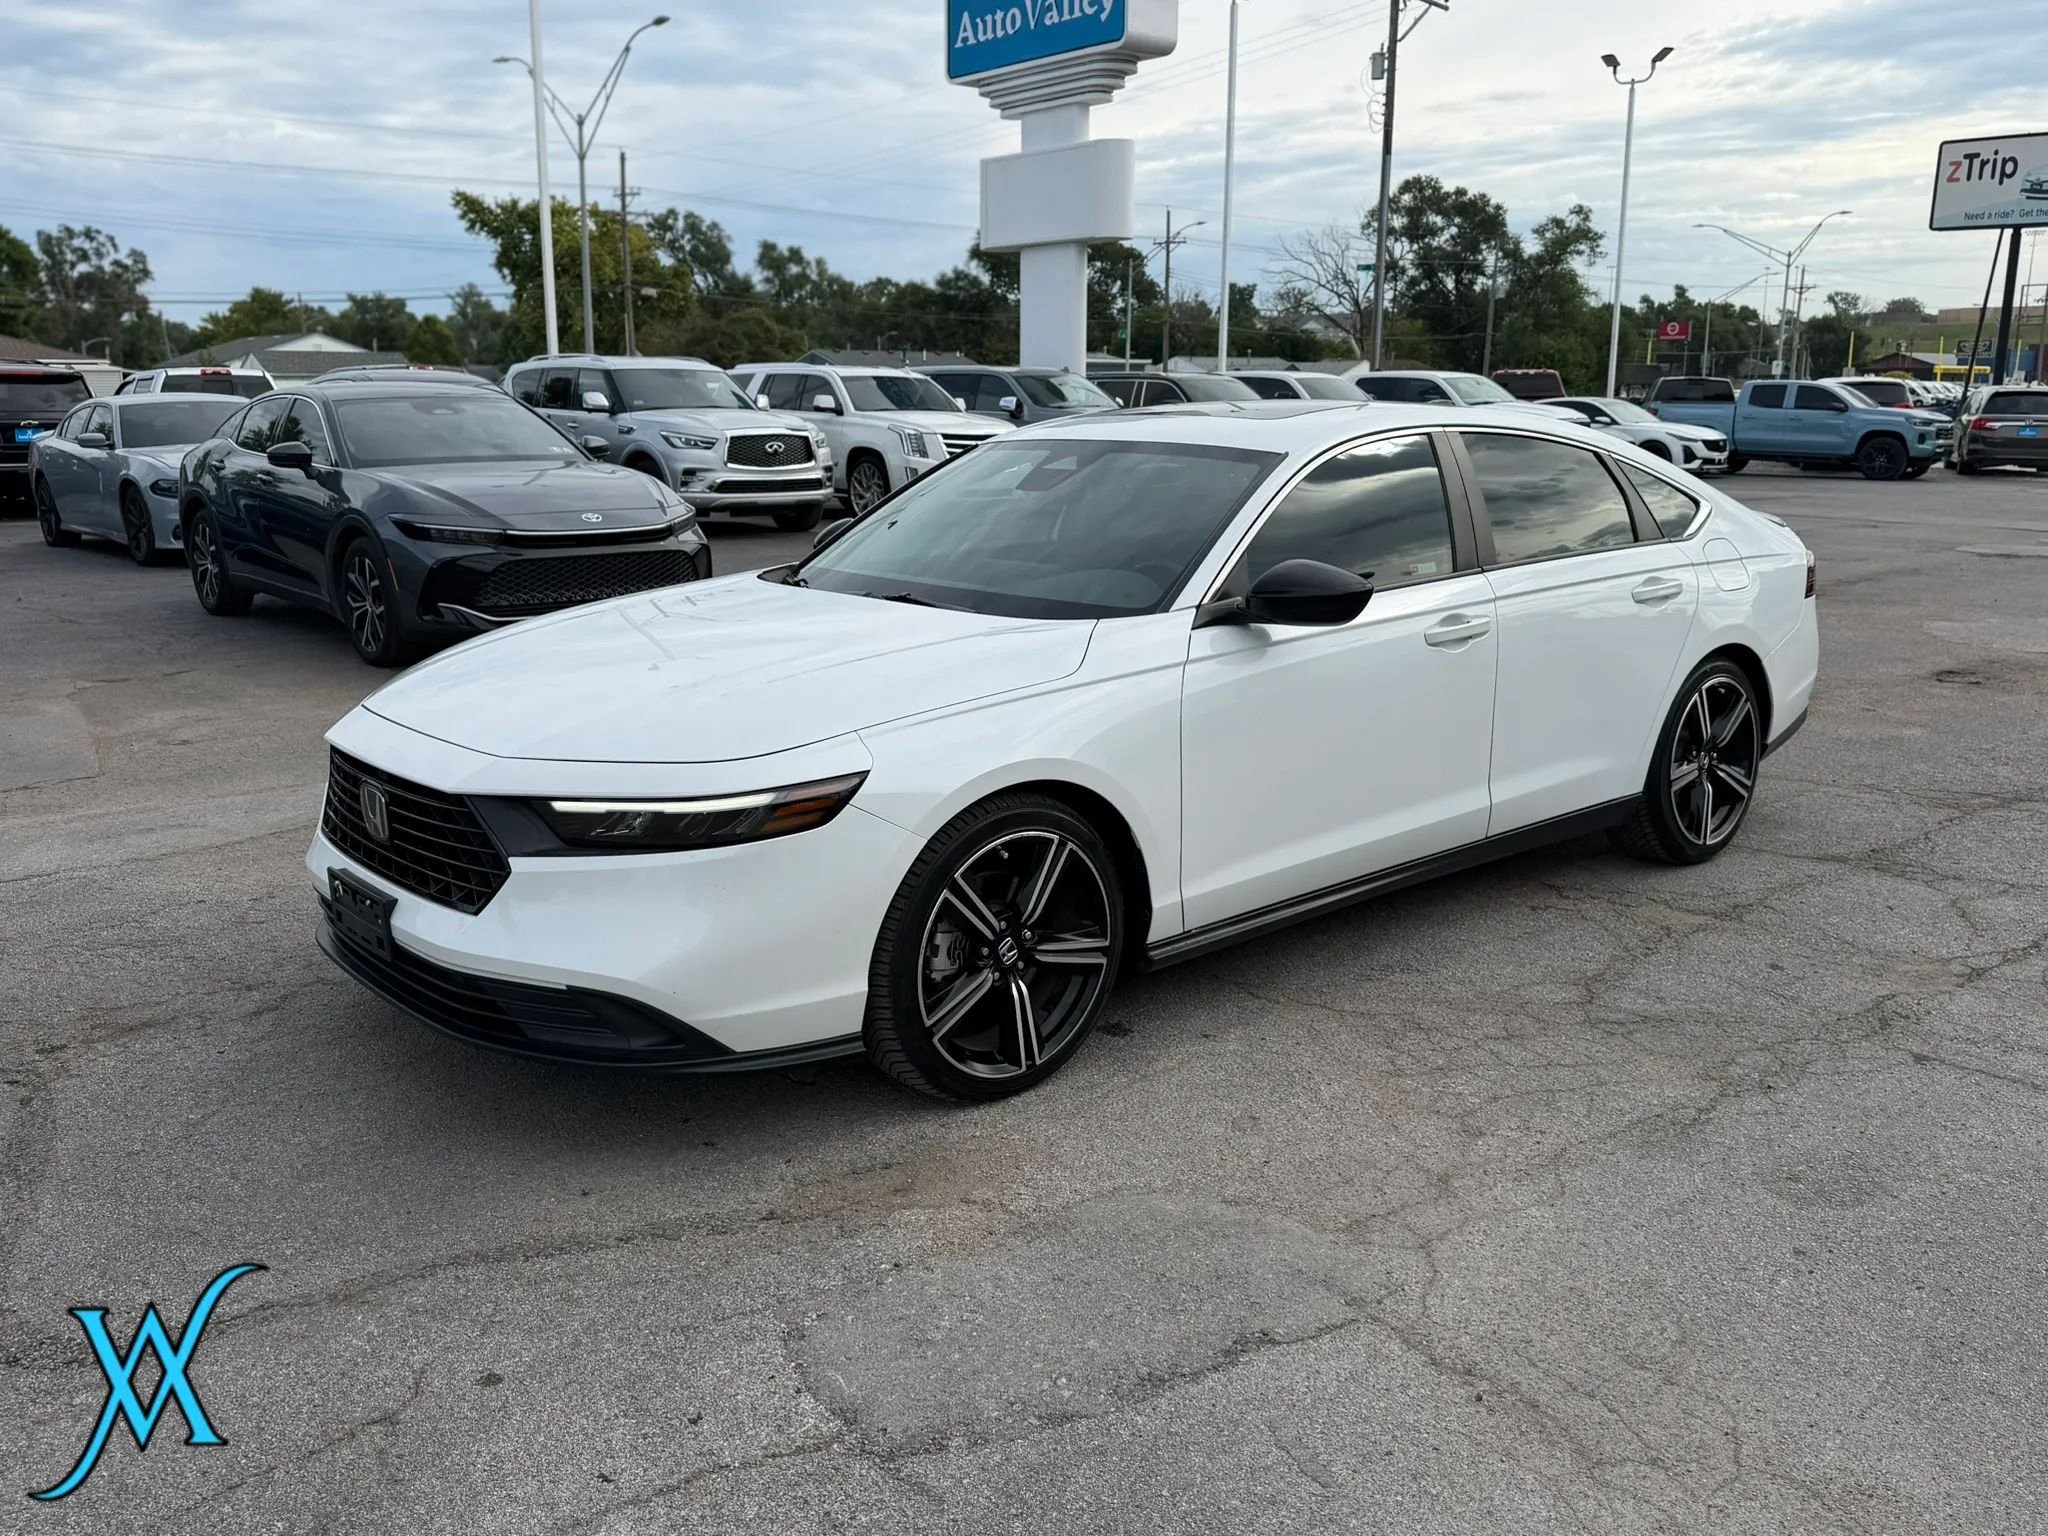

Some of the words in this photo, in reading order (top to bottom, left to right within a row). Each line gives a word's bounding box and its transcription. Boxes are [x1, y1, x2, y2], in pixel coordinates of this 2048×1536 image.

[1946, 148, 2019, 186] zTrip
[1963, 211, 1985, 221] Need
[1994, 209, 2015, 219] ride?
[2018, 208, 2034, 218] Get
